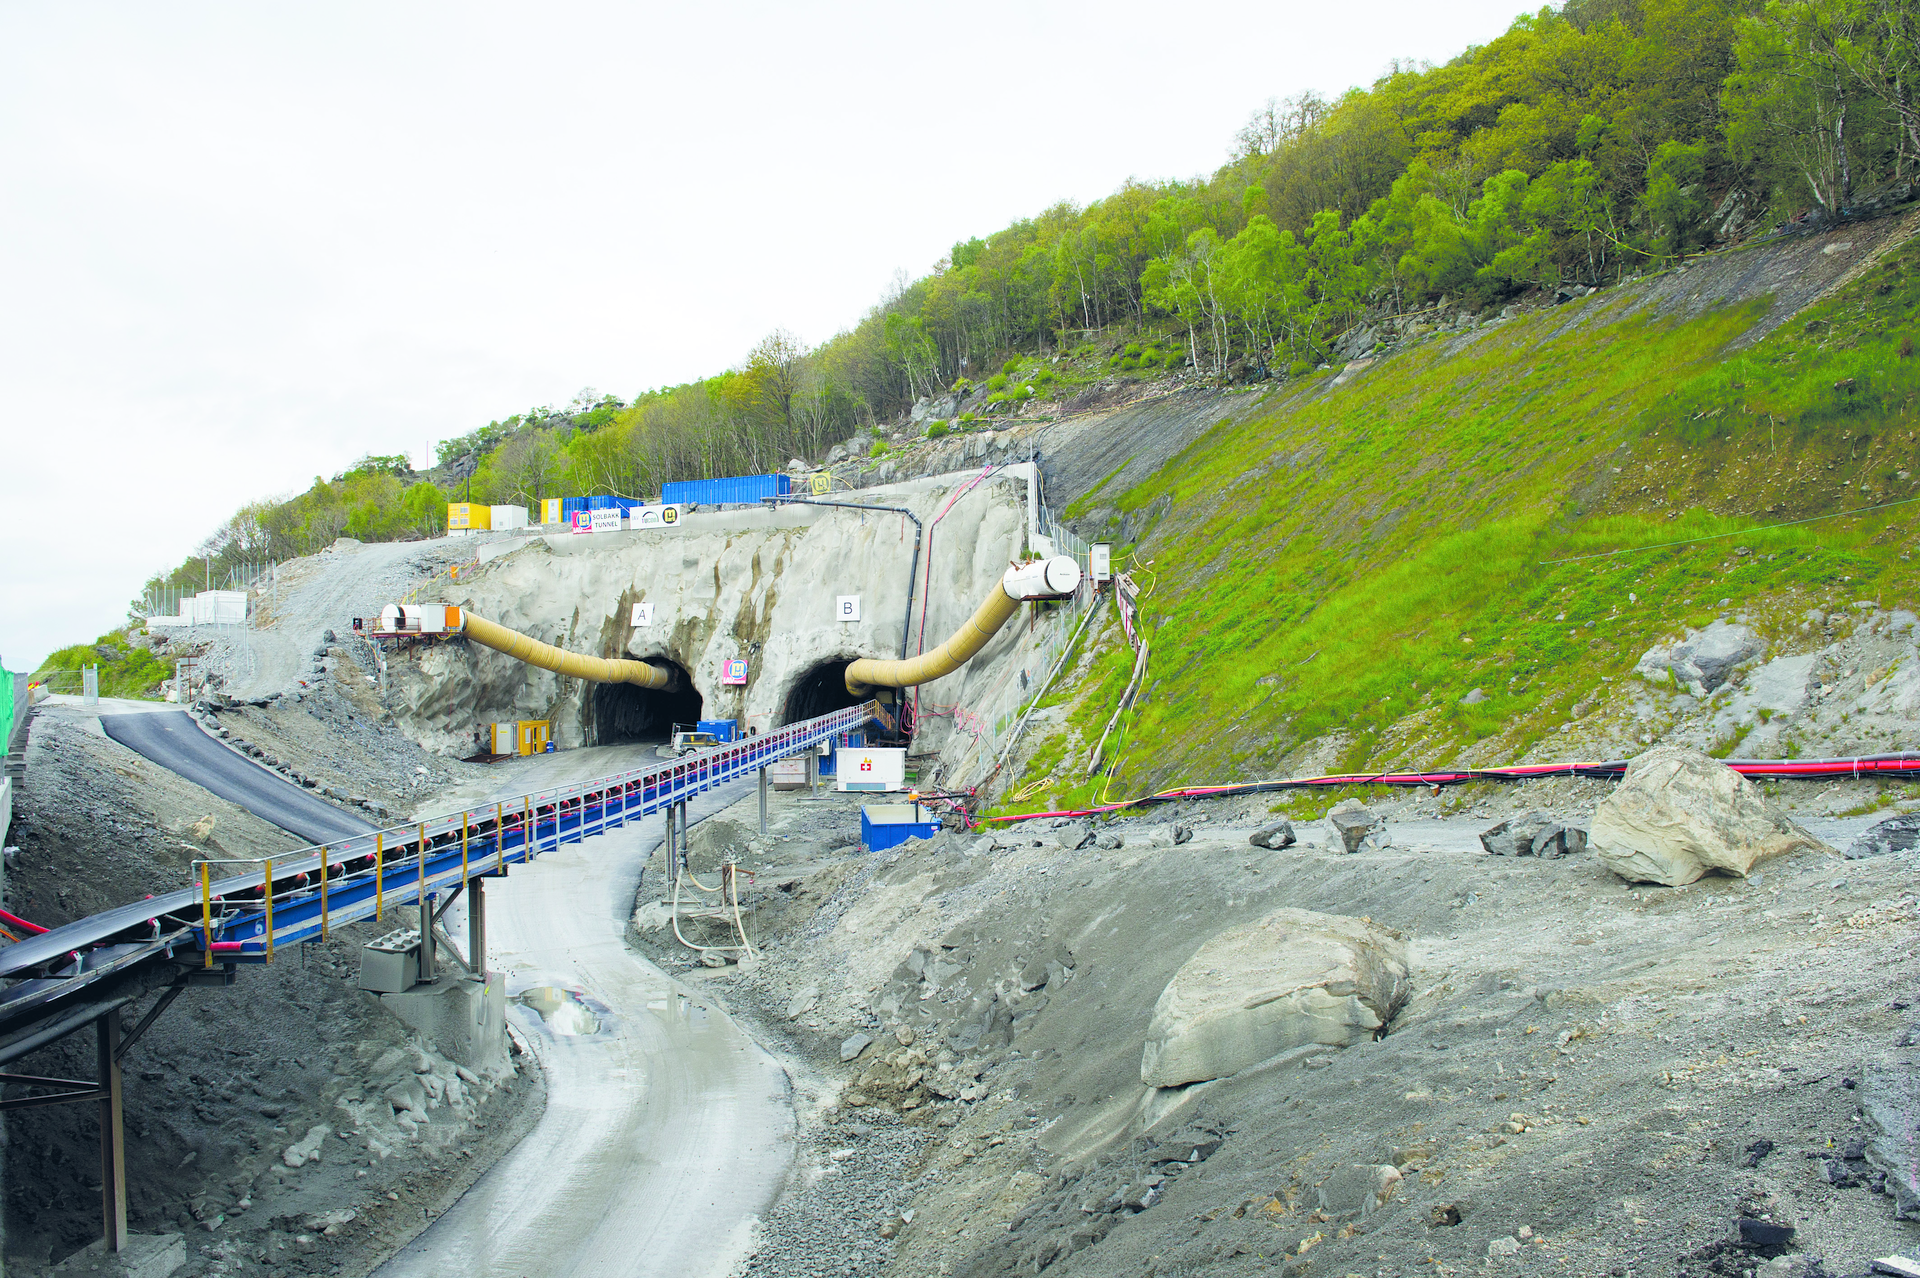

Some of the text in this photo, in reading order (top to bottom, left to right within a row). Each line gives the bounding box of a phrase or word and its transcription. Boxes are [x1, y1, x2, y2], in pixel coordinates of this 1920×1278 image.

[637, 609, 646, 620] A
[843, 601, 853, 615] B
[255, 918, 263, 935] 6
